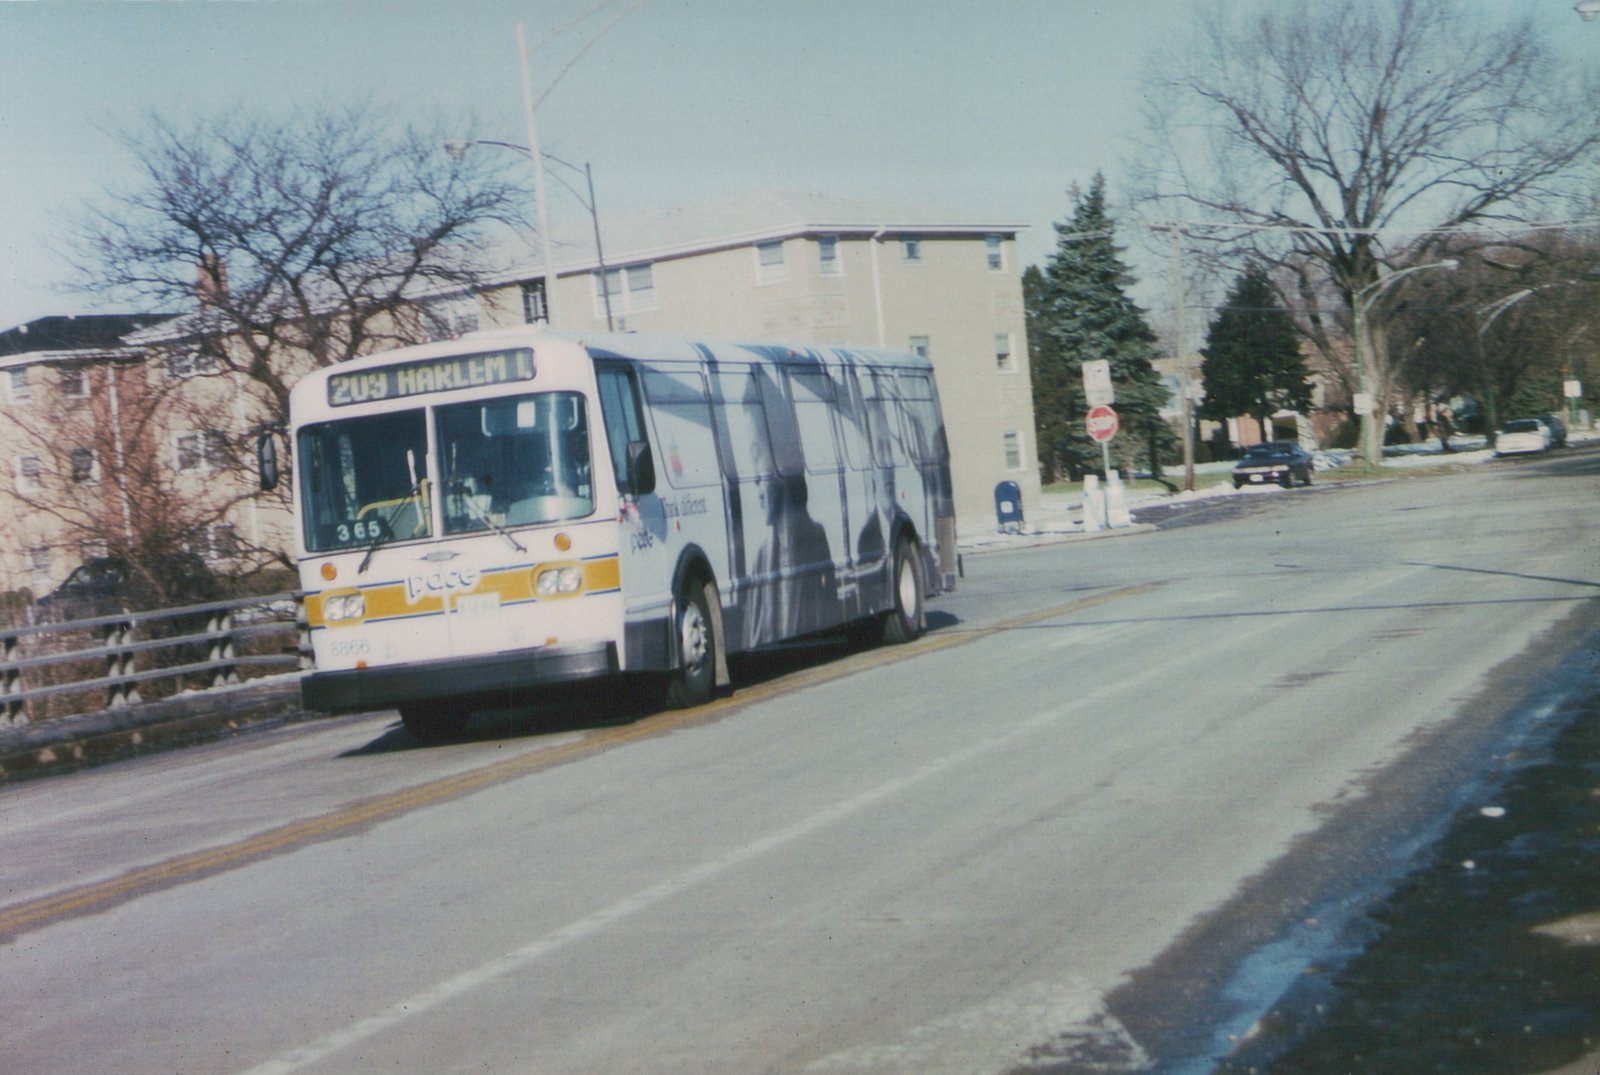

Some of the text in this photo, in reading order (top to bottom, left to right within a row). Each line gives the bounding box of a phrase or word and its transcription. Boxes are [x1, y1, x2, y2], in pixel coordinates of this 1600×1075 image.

[398, 353, 506, 394] HARLEM
[337, 520, 381, 541] 365
[407, 567, 478, 601] pace
